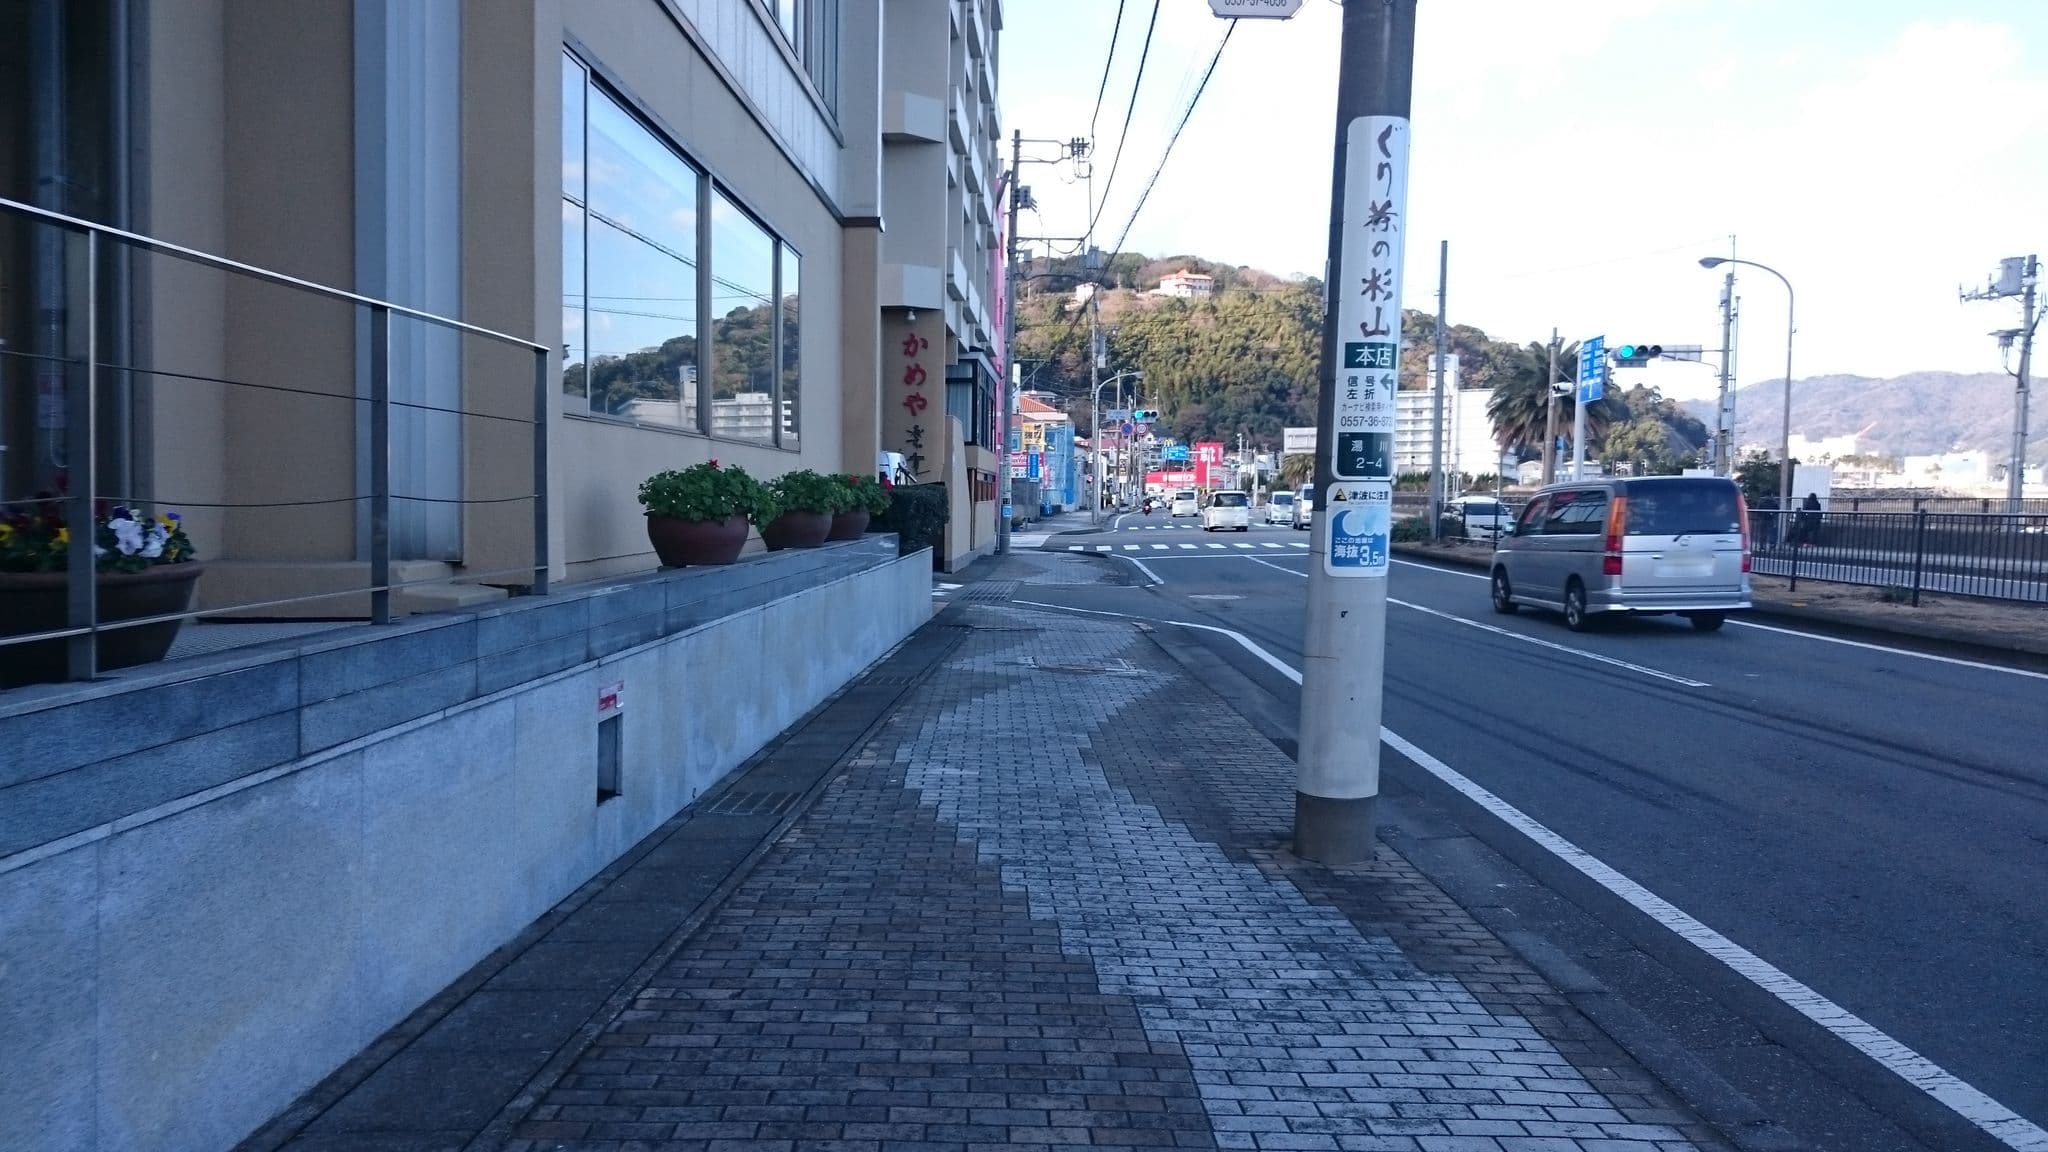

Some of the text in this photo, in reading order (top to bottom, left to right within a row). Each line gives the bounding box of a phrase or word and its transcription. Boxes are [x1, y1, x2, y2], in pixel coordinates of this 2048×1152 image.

[1360, 124, 1402, 338] ぐり茶の杉山
[1355, 346, 1392, 366] 本店
[902, 332, 929, 417] かめや
[1347, 375, 1376, 387] 信号
[1346, 388, 1375, 400] 左折
[1350, 439, 1388, 452] 湯川
[1356, 457, 1383, 469] 2-4
